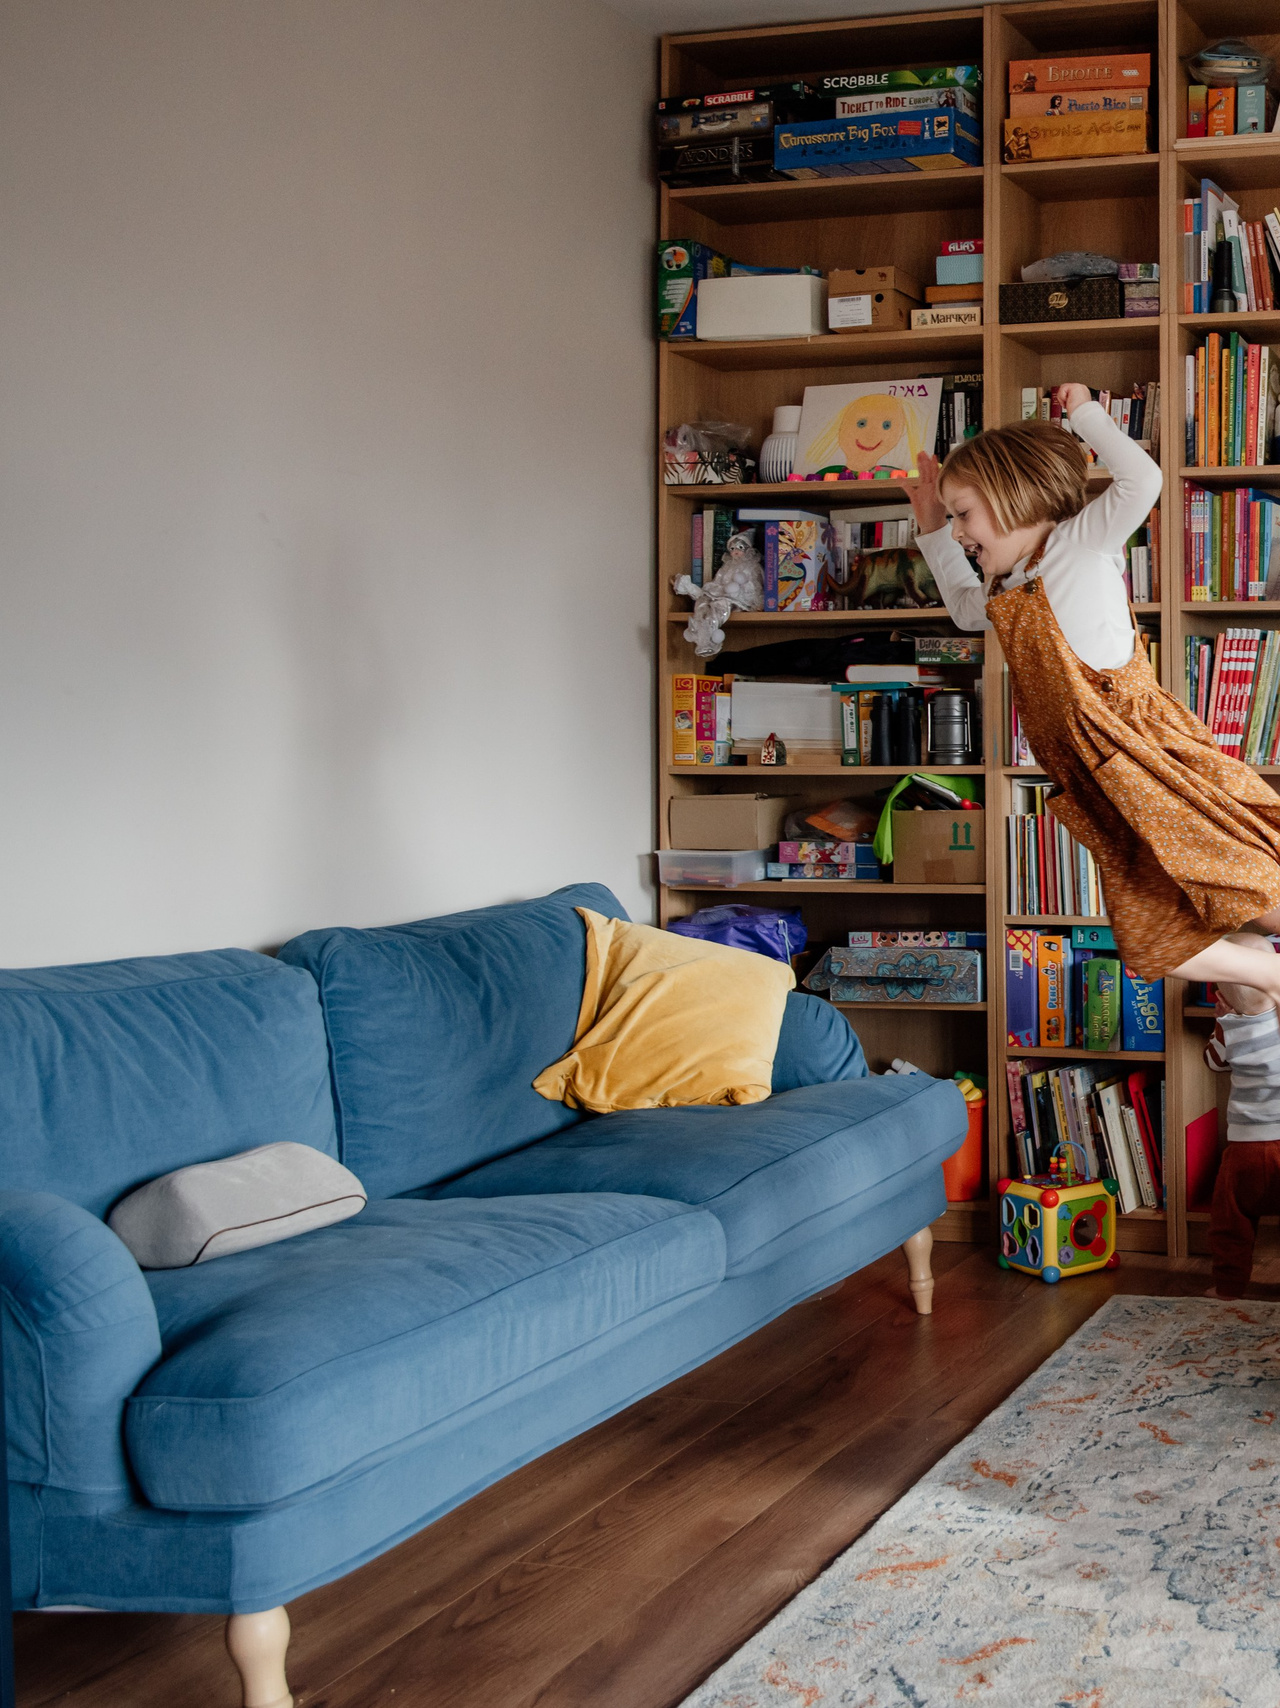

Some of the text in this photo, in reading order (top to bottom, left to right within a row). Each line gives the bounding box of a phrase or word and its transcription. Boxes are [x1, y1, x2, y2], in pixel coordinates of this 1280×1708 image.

[823, 73, 889, 89] SCRABBLE
[706, 92, 754, 105] SCRABBLE
[840, 96, 934, 114] TICKET TO RIDE EUROPE
[1067, 96, 1127, 112] Puerto Rico
[778, 123, 898, 149] Carcassonne Big Box
[1028, 120, 1126, 141] STONE AGE
[930, 313, 977, 325] Манчкин
[888, 384, 929, 397] מאיה
[676, 679, 693, 689] IQ
[698, 680, 711, 692] IQ
